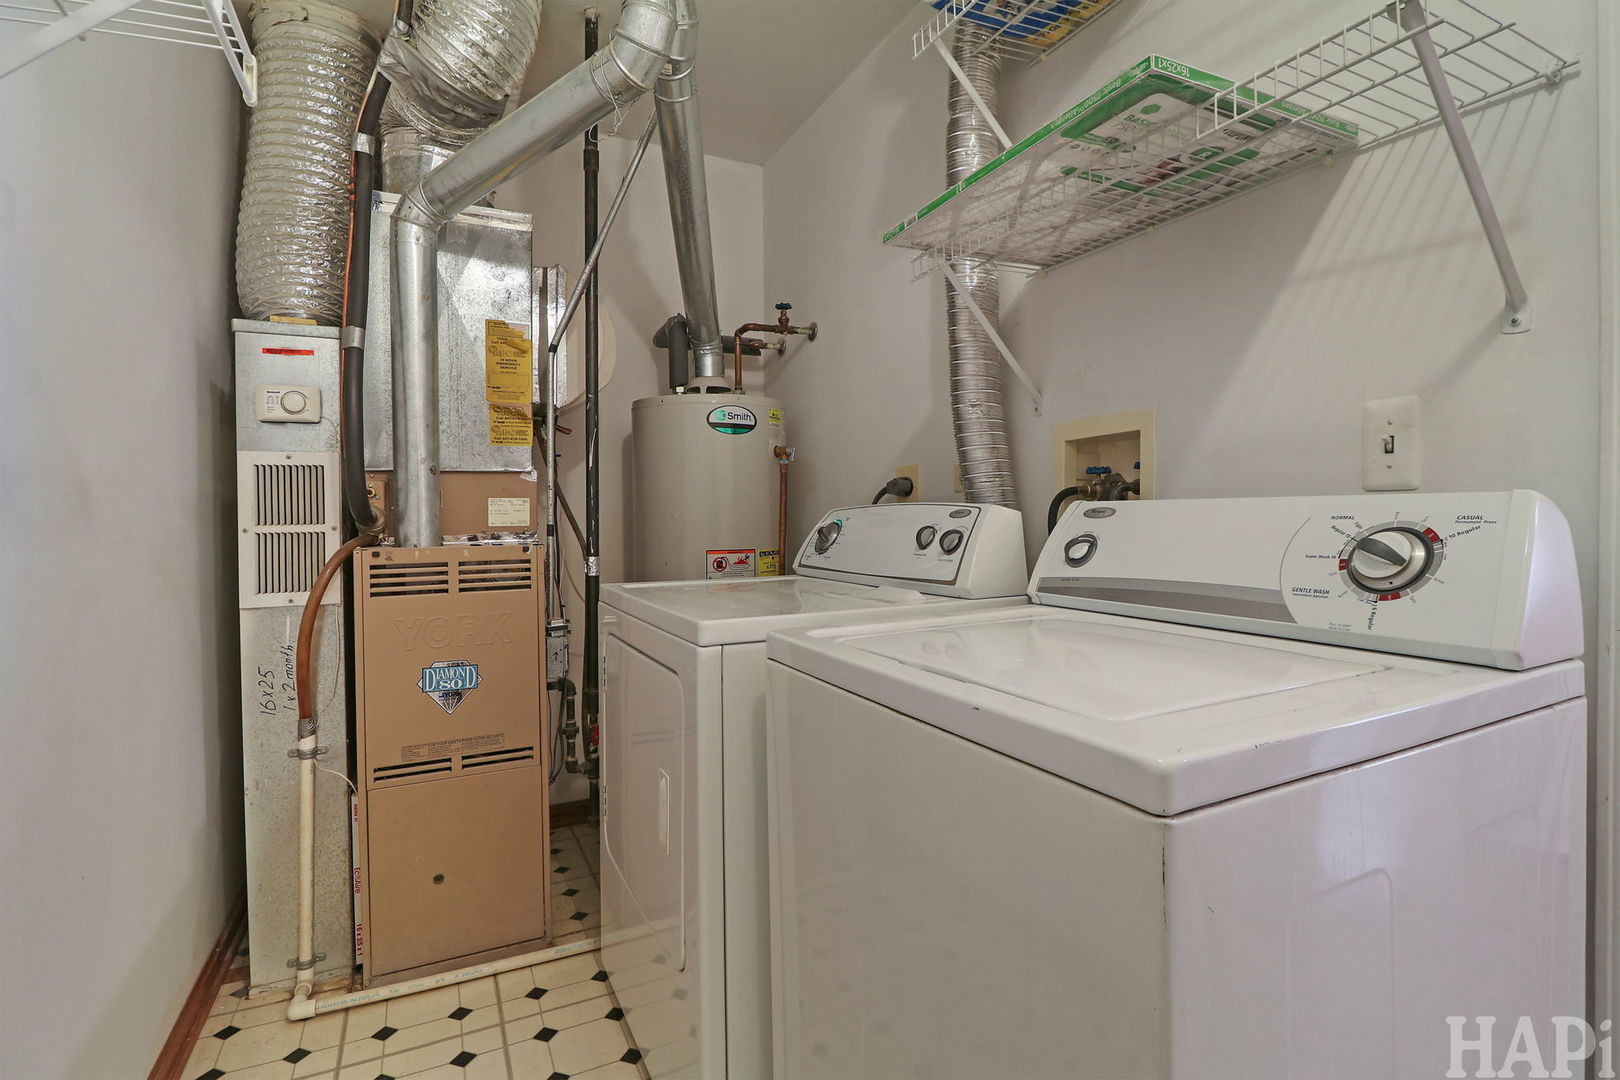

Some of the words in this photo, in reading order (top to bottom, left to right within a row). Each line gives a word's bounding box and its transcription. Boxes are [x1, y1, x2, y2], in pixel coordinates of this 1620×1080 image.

[1158, 58, 1190, 77] 16x25x1
[727, 411, 751, 421] Smith
[393, 611, 513, 652] YORK
[425, 666, 477, 691] DIAMOND
[439, 679, 462, 690] 80
